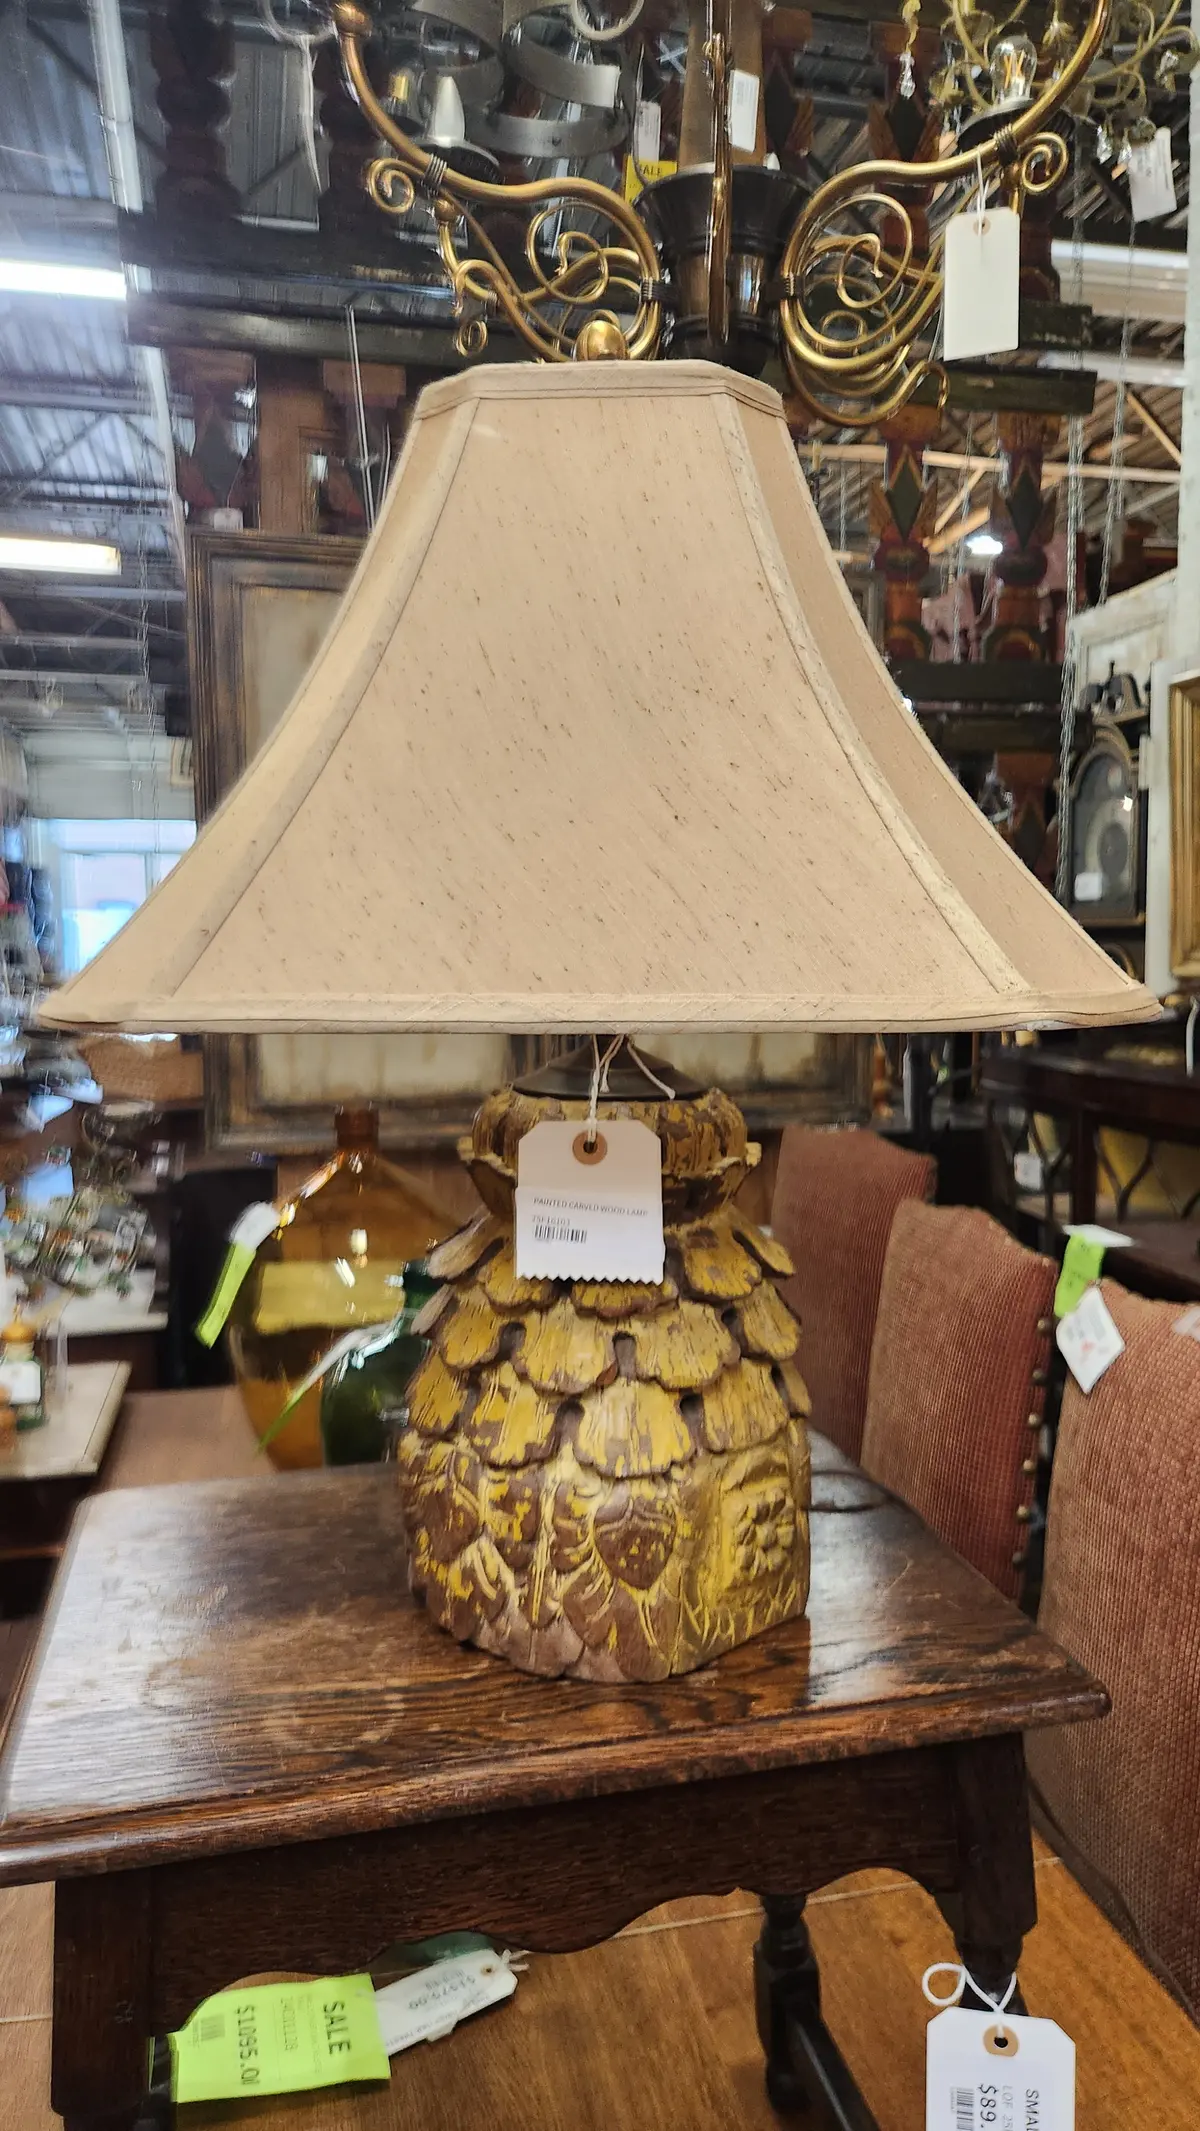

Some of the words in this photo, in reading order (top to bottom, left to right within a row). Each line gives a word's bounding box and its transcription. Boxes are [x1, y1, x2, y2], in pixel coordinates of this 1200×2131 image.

[533, 1197, 568, 1209] PAINTED
[569, 1200, 599, 1212] CARVED
[600, 1204, 625, 1215] WOOD
[626, 1207, 648, 1217] LAMP
[323, 2000, 352, 2056] SALE
[978, 2083, 999, 2129] $89.
